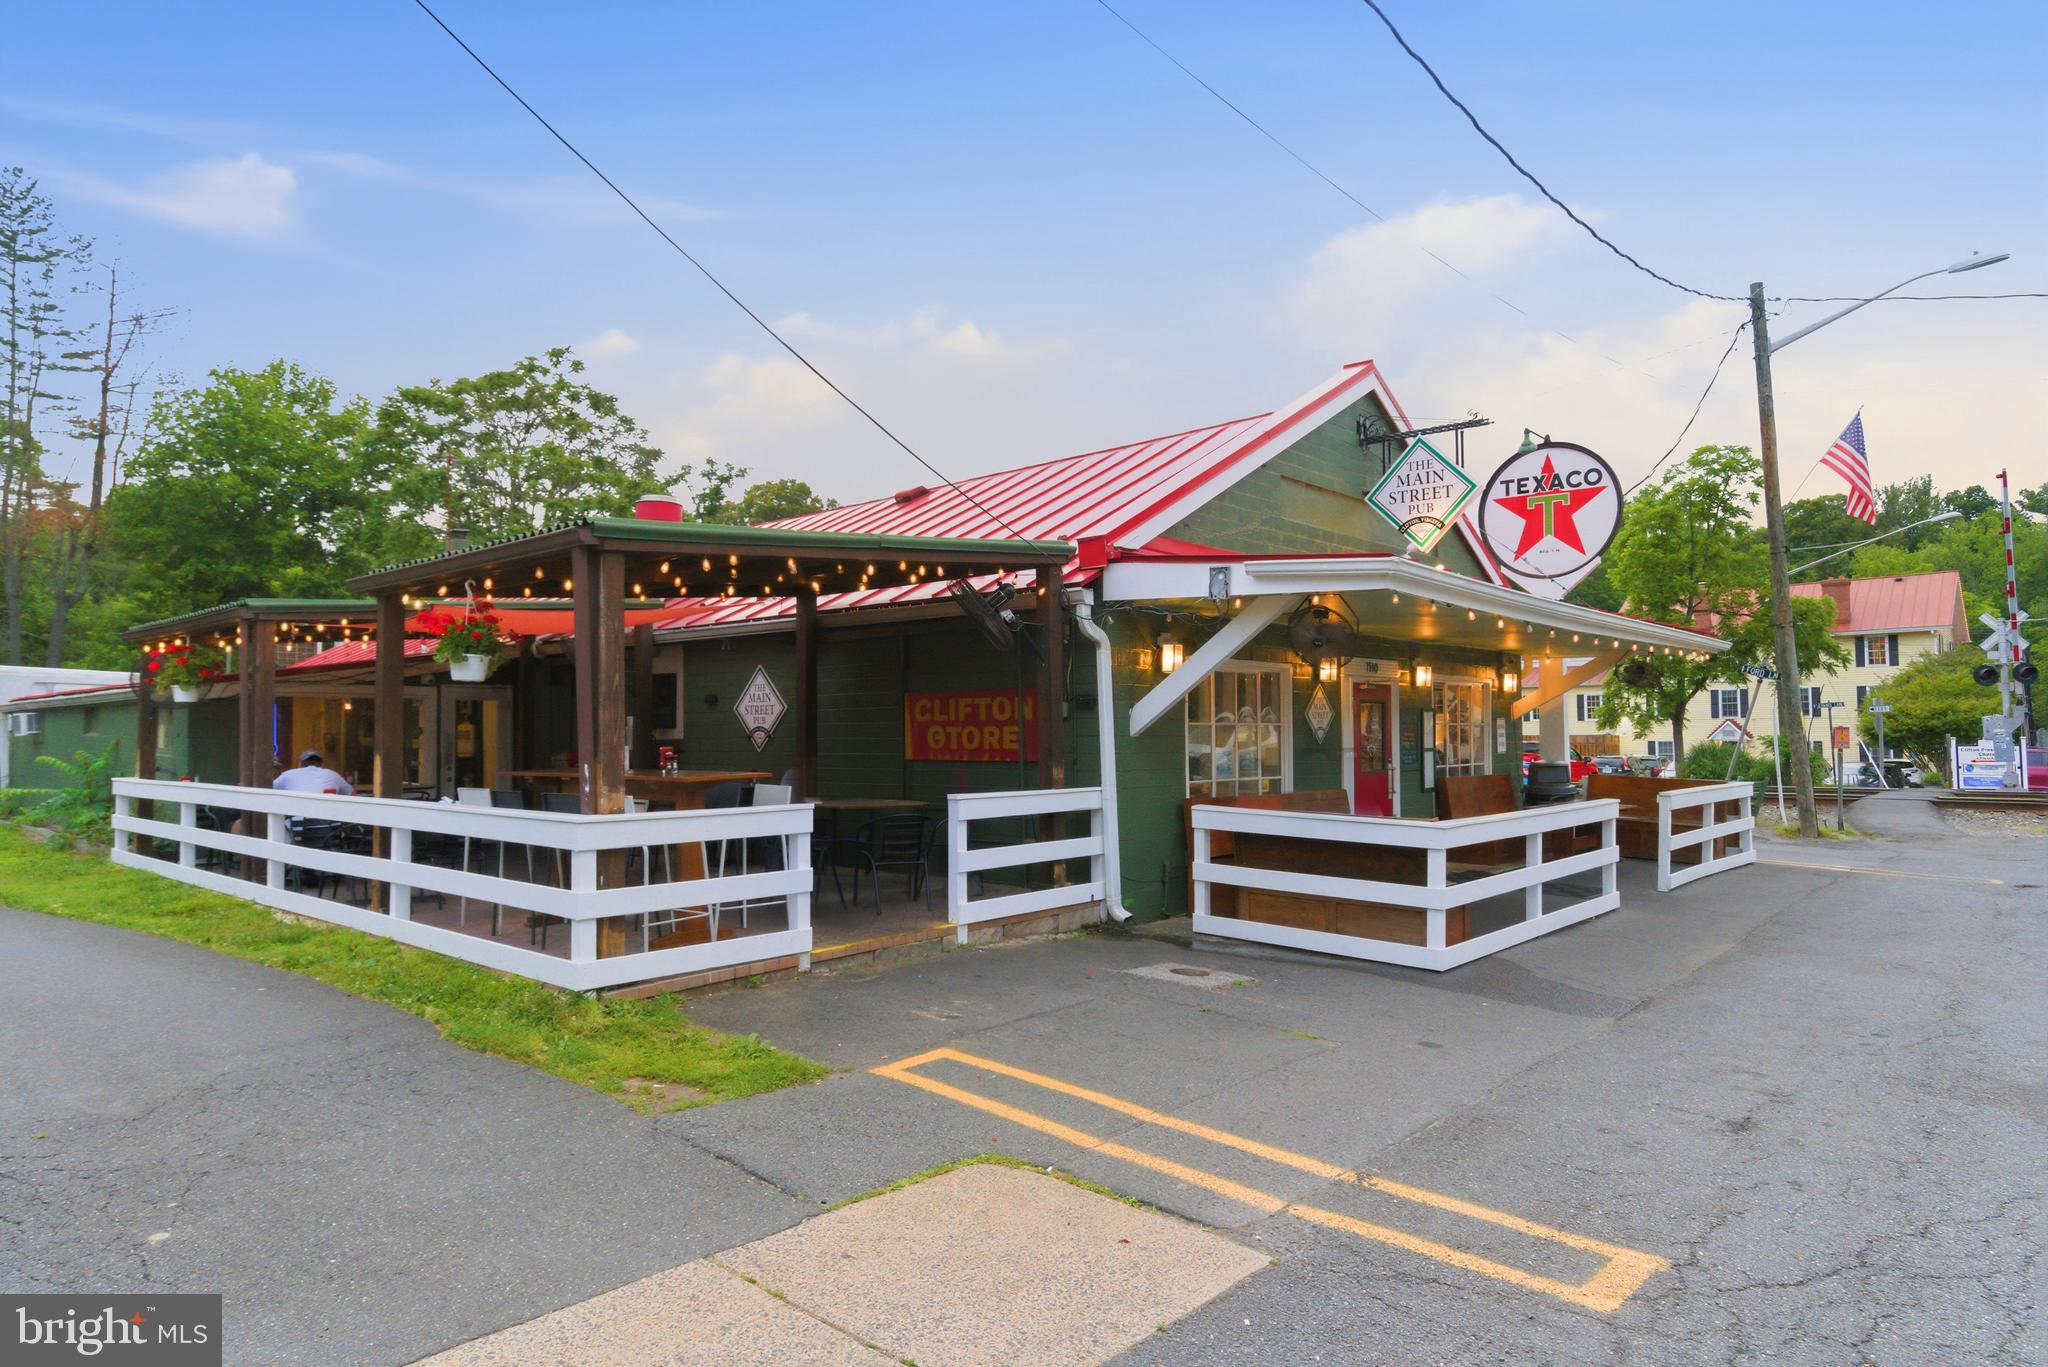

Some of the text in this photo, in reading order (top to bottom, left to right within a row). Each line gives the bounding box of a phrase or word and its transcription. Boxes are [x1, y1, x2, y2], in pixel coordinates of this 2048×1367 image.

[1407, 459, 1434, 472] THE
[1396, 469, 1445, 488] MAIN
[1500, 468, 1603, 497] TEXACO
[1388, 484, 1454, 505] STREET
[1408, 503, 1434, 515] PUB
[753, 684, 766, 692] THE
[749, 692, 771, 703] MAIN
[744, 704, 775, 715] STREET
[914, 696, 1033, 722] CLIFTON
[753, 716, 766, 724] PUB
